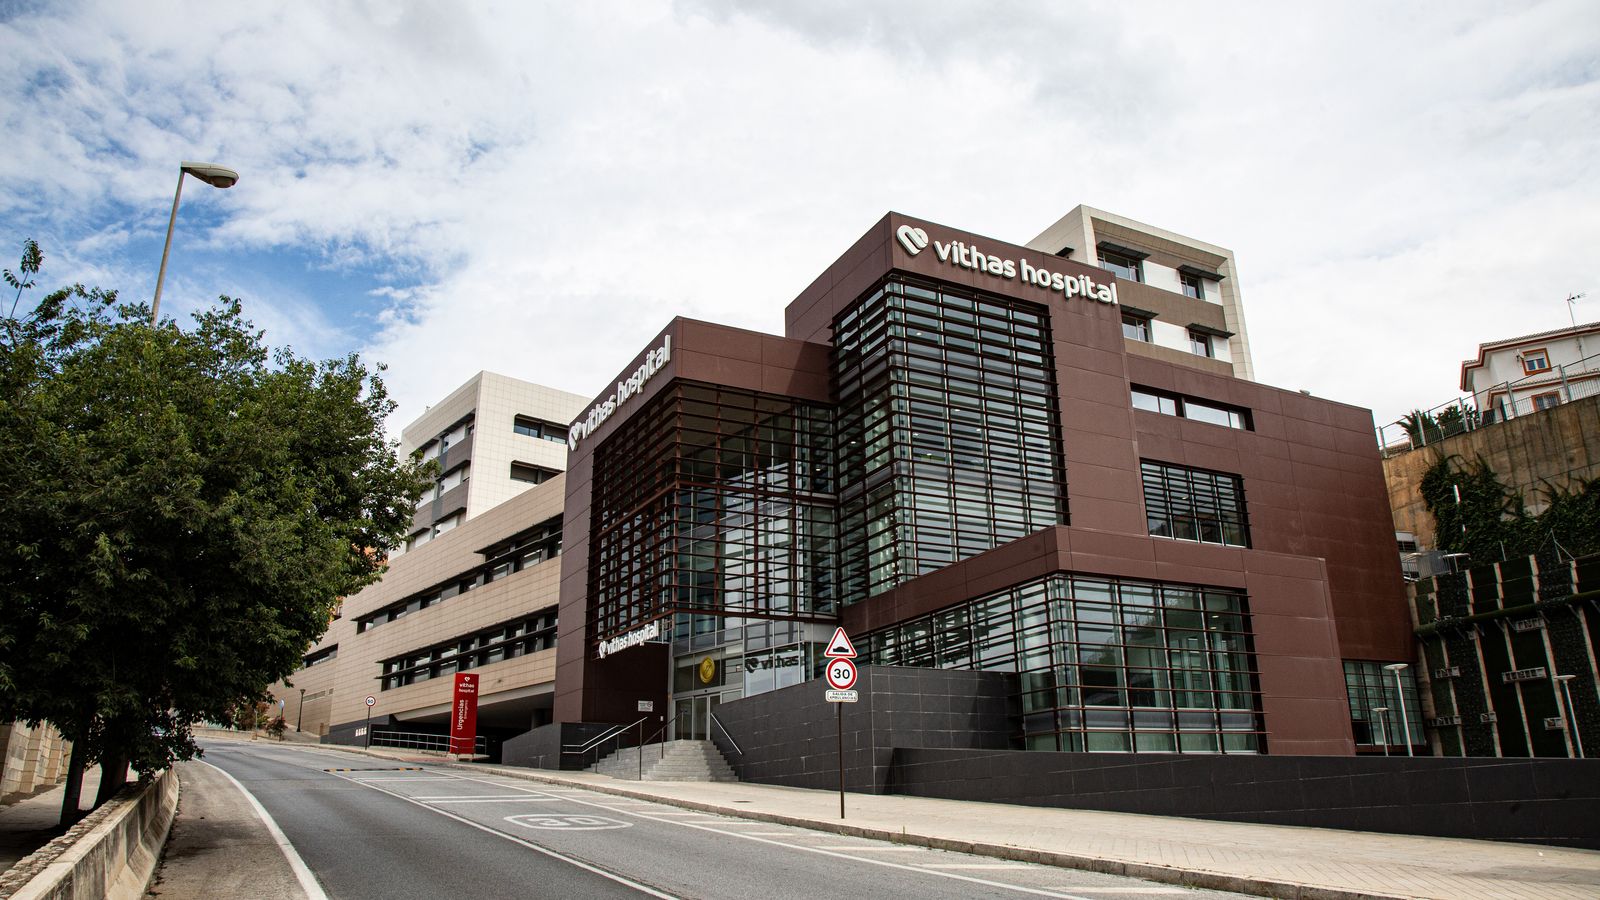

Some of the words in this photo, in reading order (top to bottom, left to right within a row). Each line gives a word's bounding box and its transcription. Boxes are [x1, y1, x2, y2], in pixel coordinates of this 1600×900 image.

[933, 240, 1016, 278] vithas
[1020, 258, 1118, 305] hospital
[581, 394, 616, 439] vithas
[617, 334, 671, 406] hospital
[607, 636, 628, 655] vithas
[628, 620, 659, 646] hospital
[833, 668, 850, 679] 30
[457, 699, 465, 730] Urgencias
